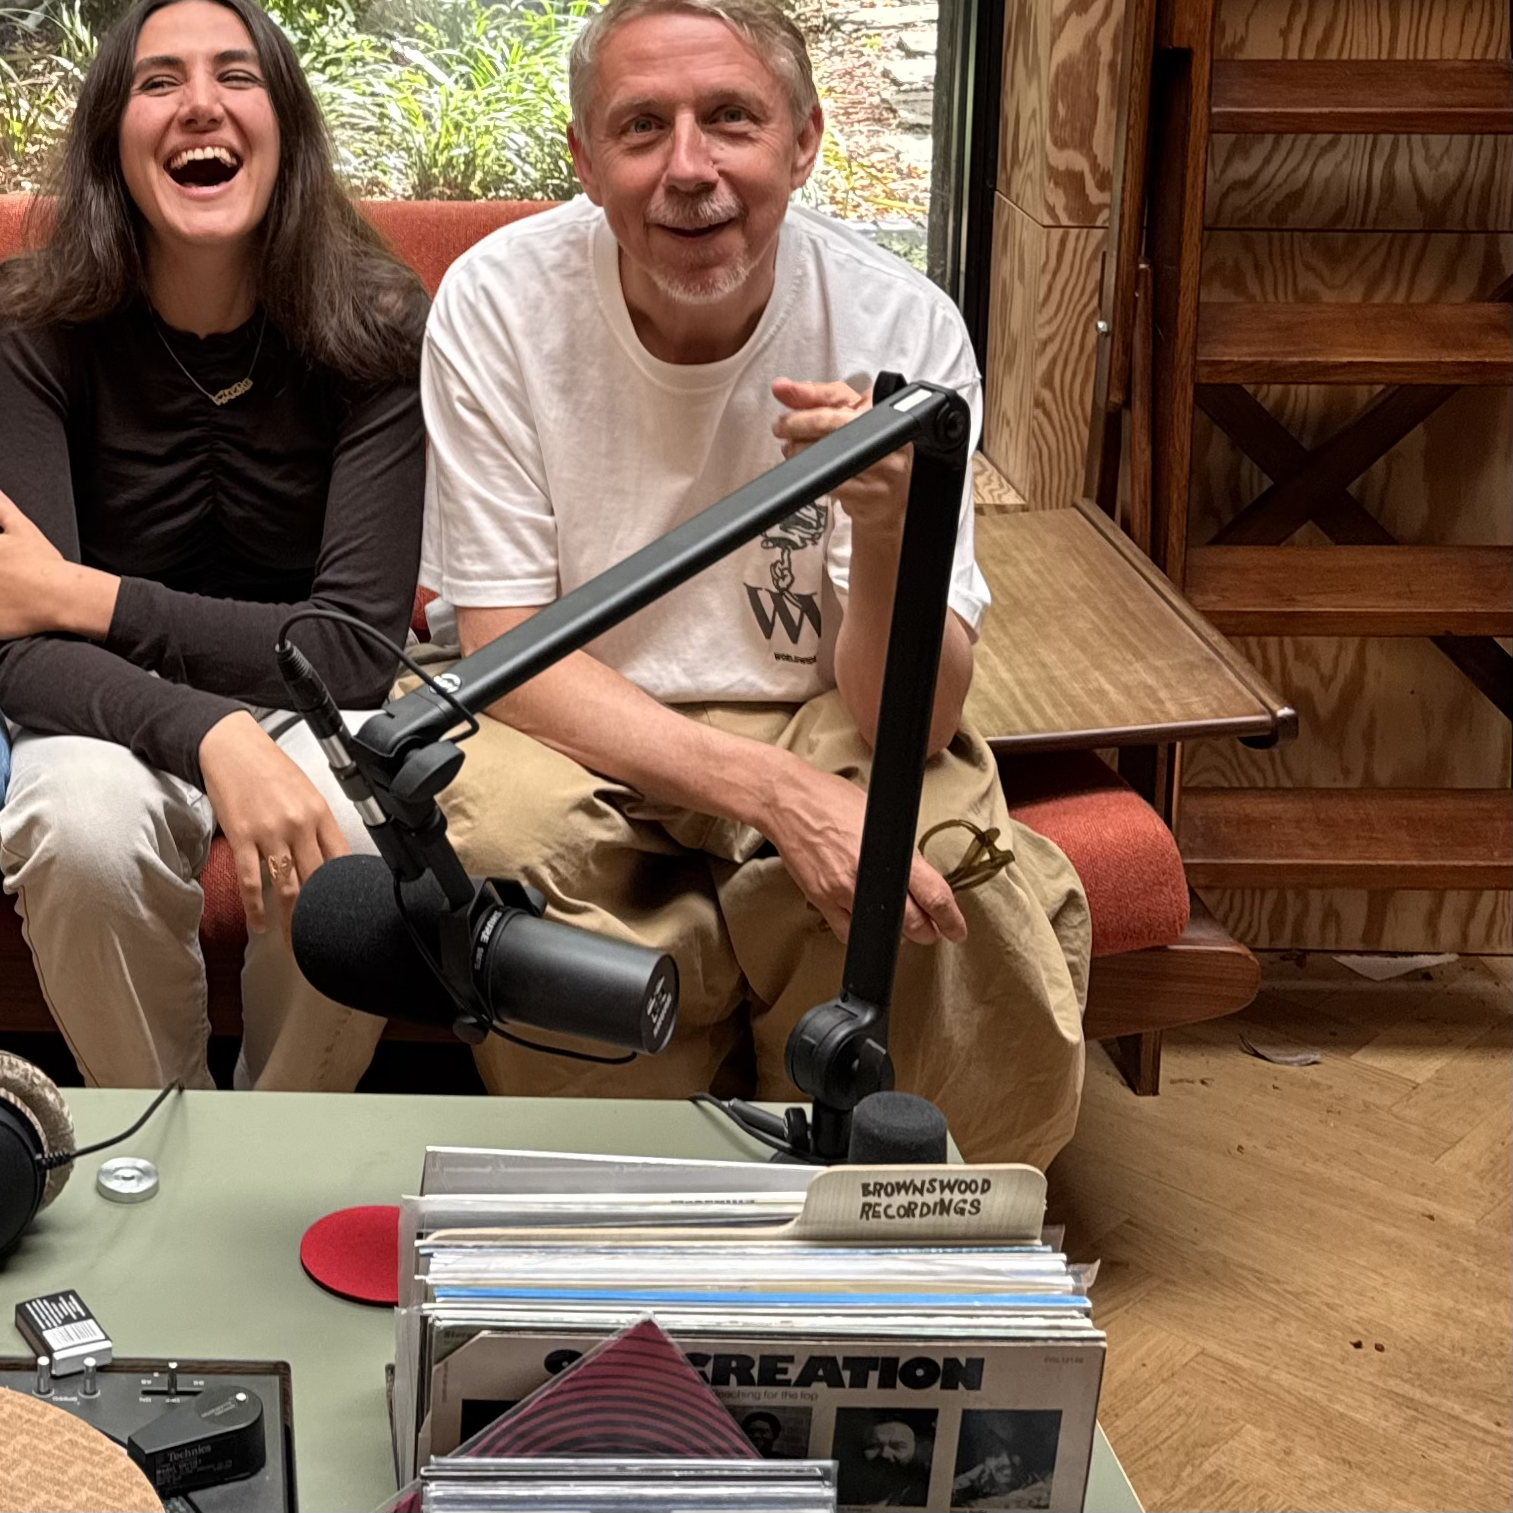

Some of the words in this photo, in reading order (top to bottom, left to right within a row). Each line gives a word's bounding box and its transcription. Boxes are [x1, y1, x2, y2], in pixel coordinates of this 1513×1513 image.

[480, 909, 503, 944] SHURE
[861, 1178, 992, 1199] BROWNSWOOD
[860, 1197, 982, 1221] RECORDINGS
[763, 1389, 780, 1399] for
[781, 1390, 798, 1400] the
[800, 1390, 819, 1402] top
[167, 1443, 213, 1463] Technics
